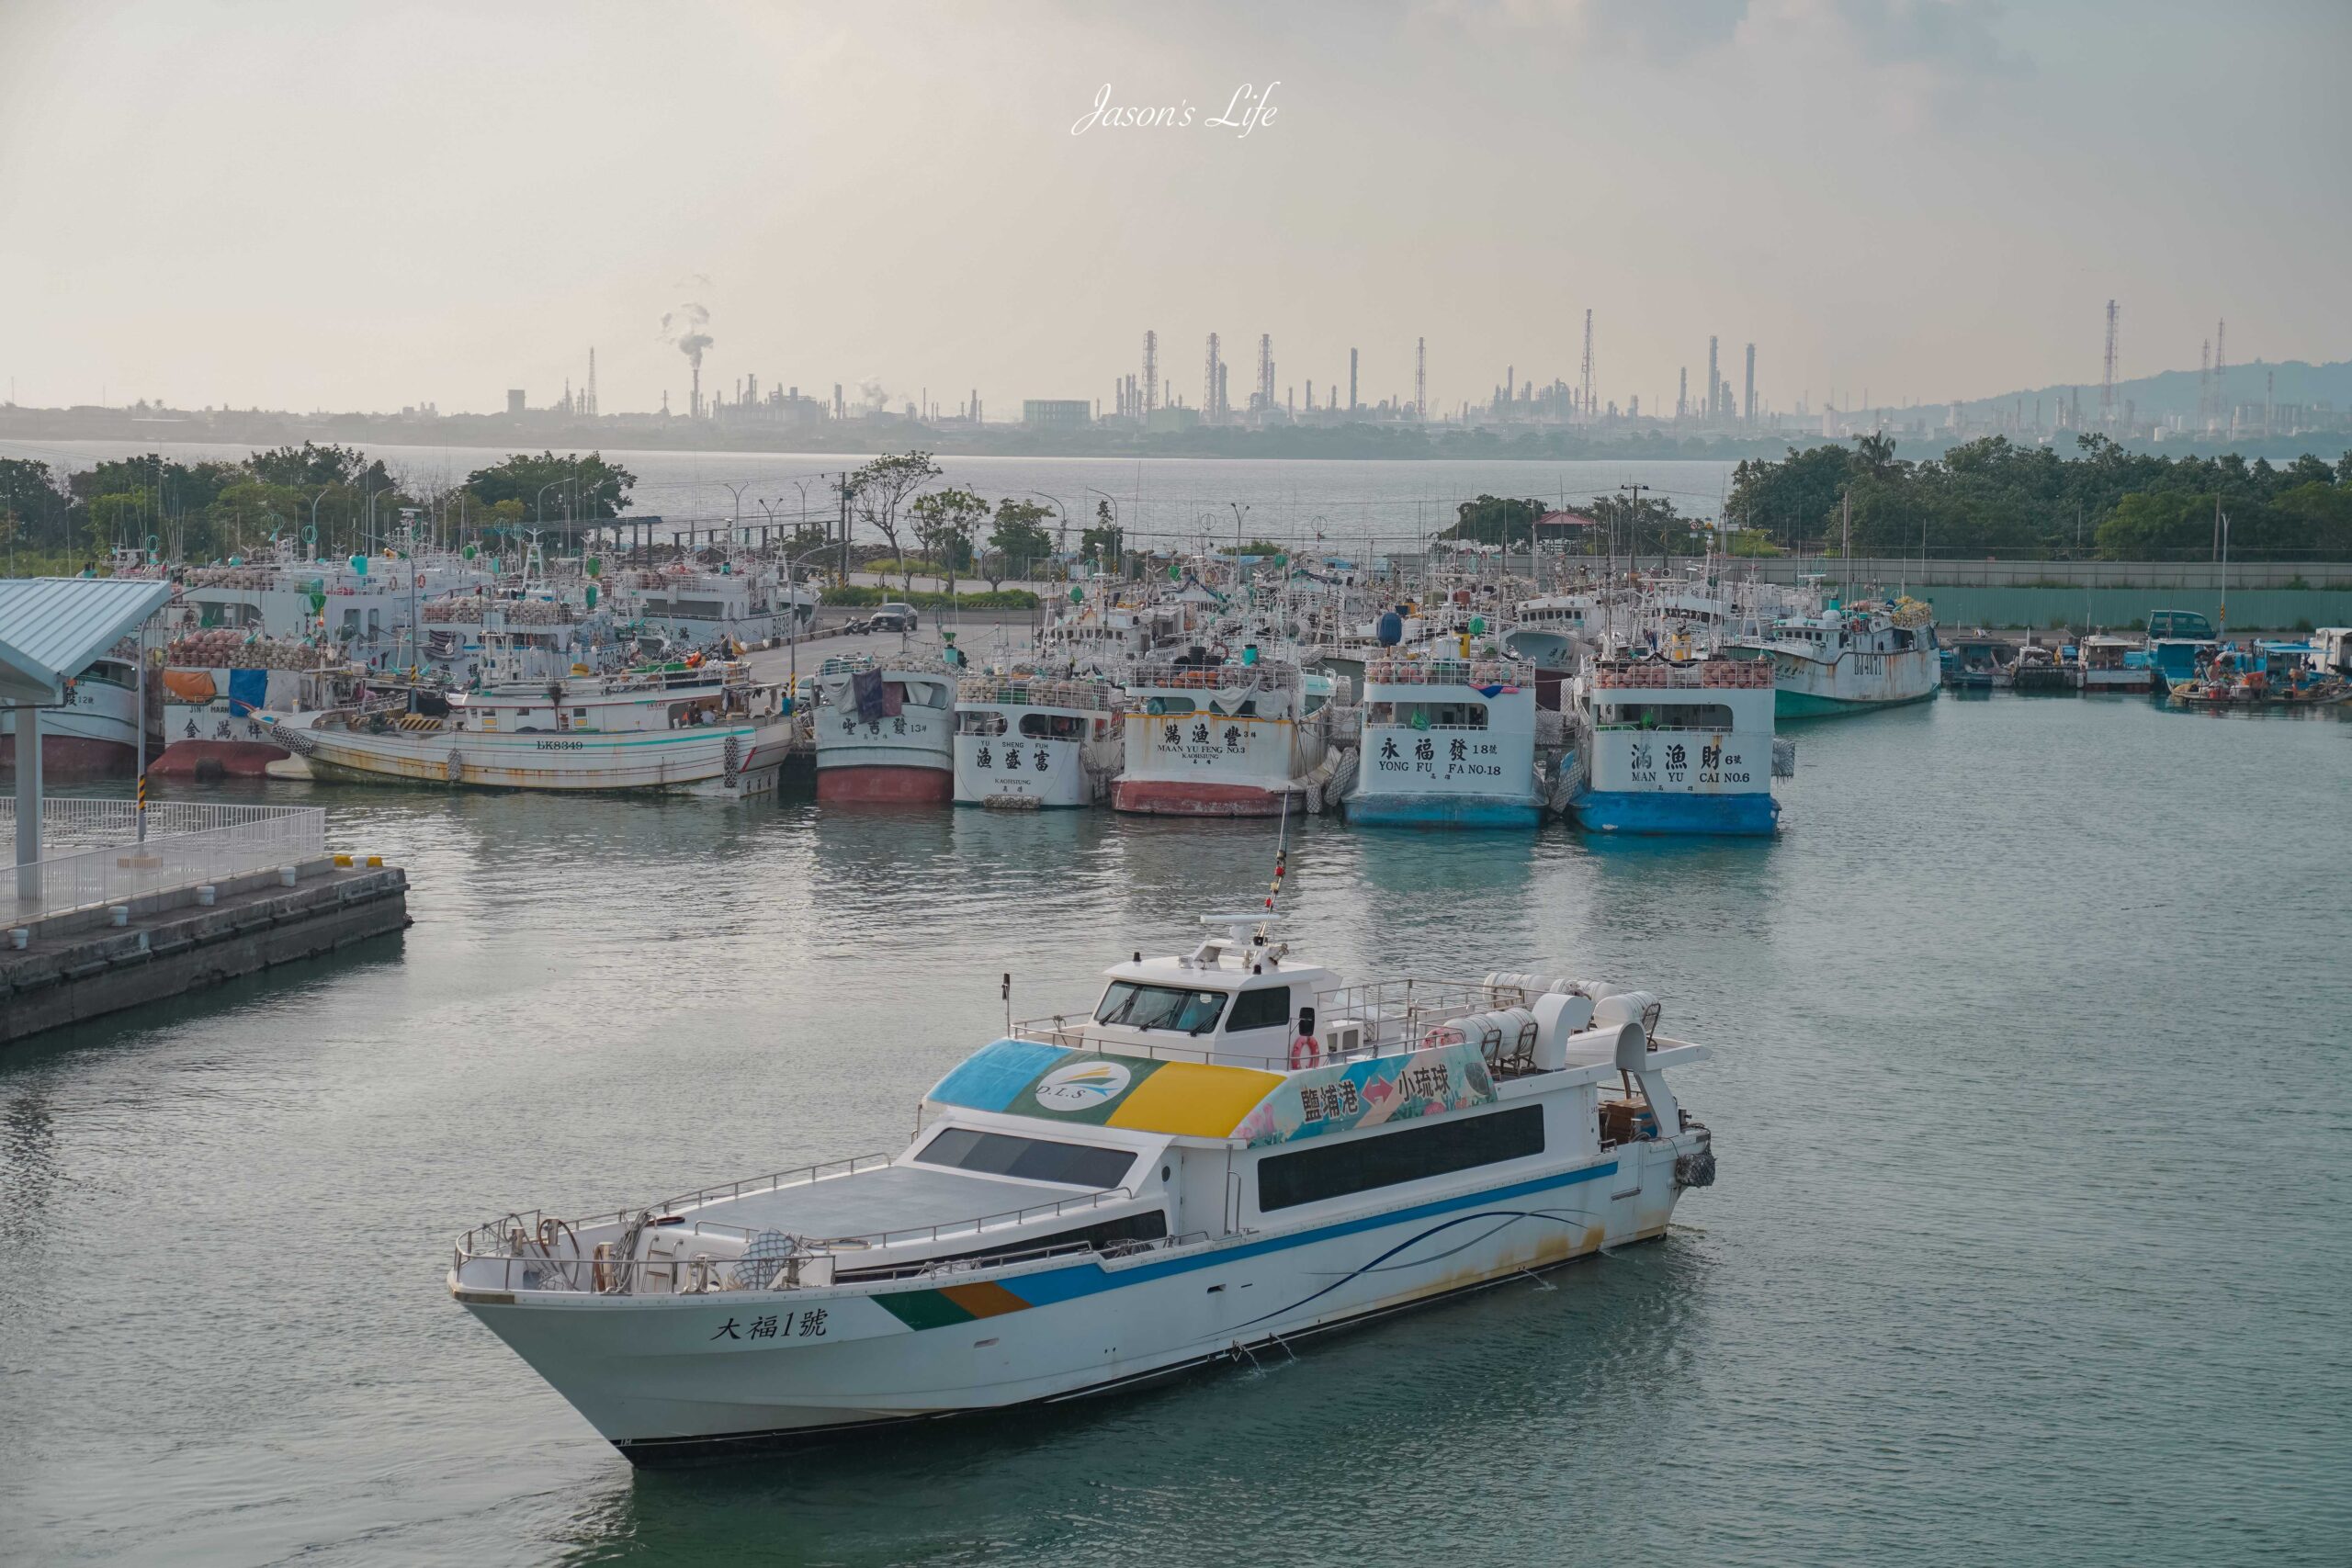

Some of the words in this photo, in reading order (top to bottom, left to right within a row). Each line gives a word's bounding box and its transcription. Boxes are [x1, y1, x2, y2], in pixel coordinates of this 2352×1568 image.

[1158, 744, 1183, 752] MAAN
[977, 747, 1050, 773] 漁盛富
[1379, 761, 1408, 772] YONG
[1416, 762, 1432, 773] FU
[1449, 763, 1464, 774] FA
[1468, 764, 1501, 775] NO.18
[1632, 772, 1657, 782] MAN
[1668, 773, 1684, 782] YU
[1700, 773, 1720, 783] CAI
[1724, 773, 1750, 783] NO.6
[1301, 1079, 1359, 1122] 鹽埔港
[1398, 1065, 1451, 1102] 小琉球
[710, 1308, 828, 1340] 大福1號
